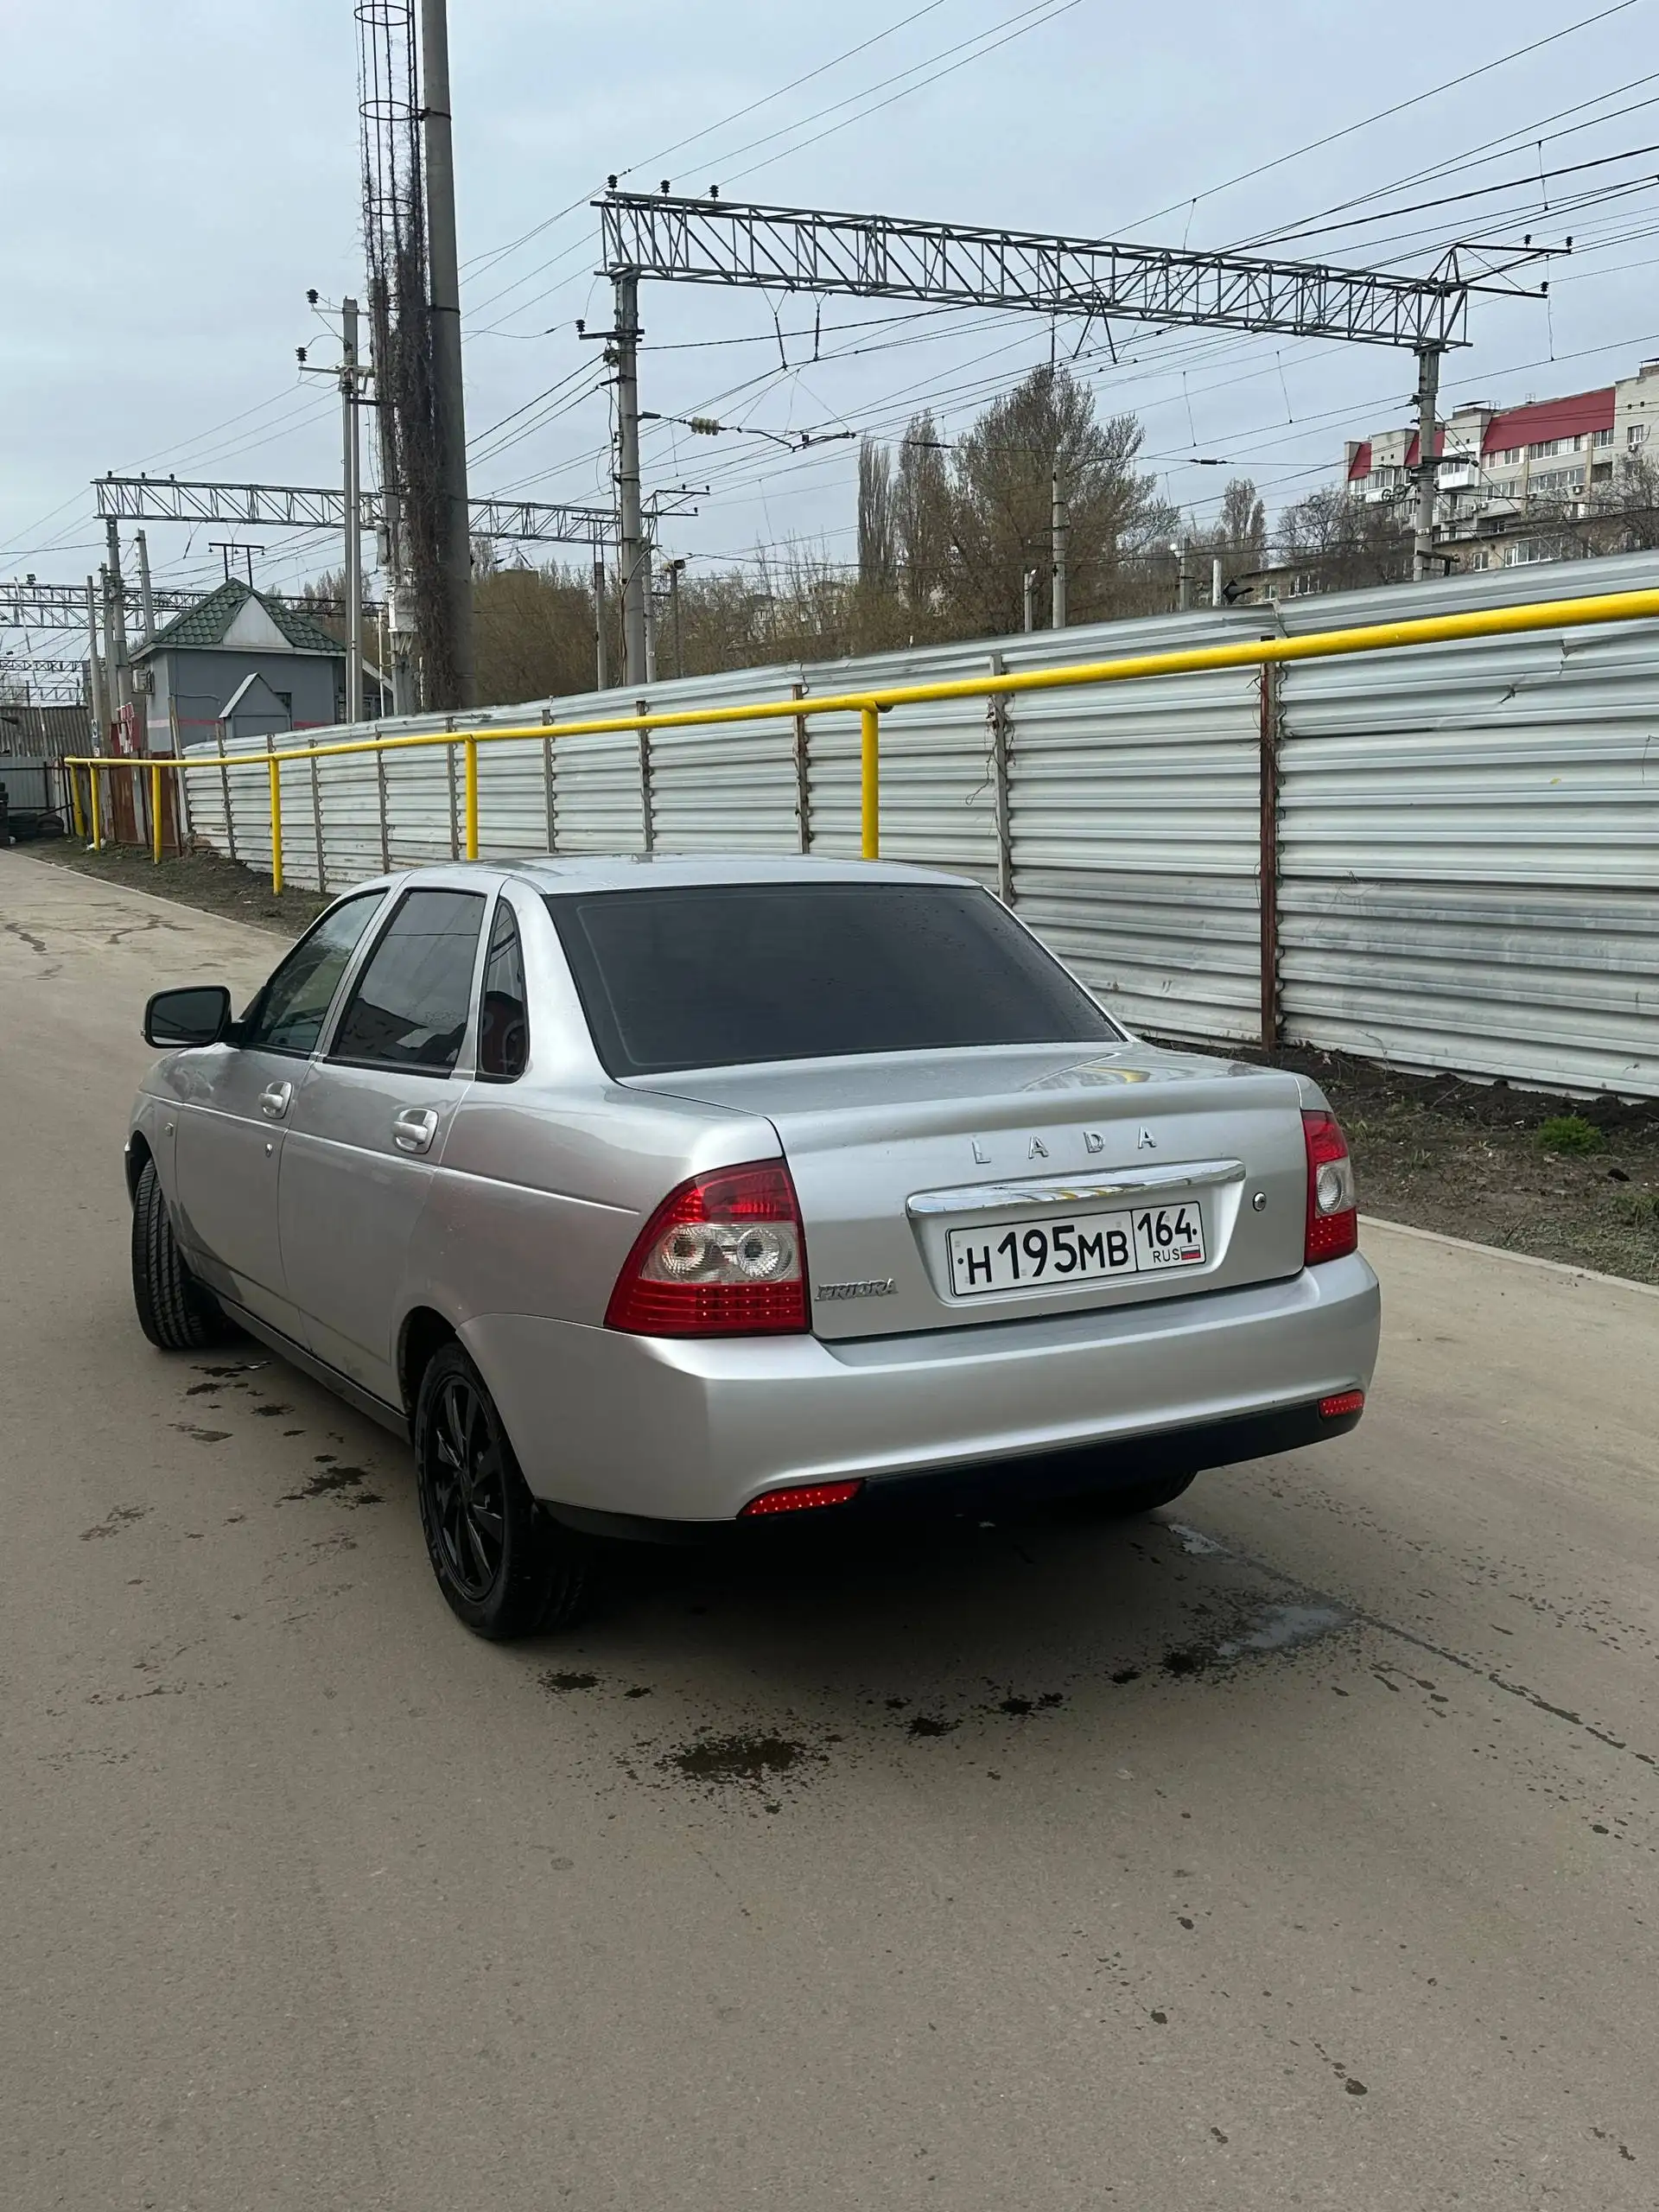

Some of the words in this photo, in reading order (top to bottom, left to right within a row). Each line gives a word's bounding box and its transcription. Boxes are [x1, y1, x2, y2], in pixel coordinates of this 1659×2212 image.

[971, 1126, 1158, 1165] LADA
[1137, 1208, 1193, 1249] 164
[1154, 1247, 1180, 1263] RUS
